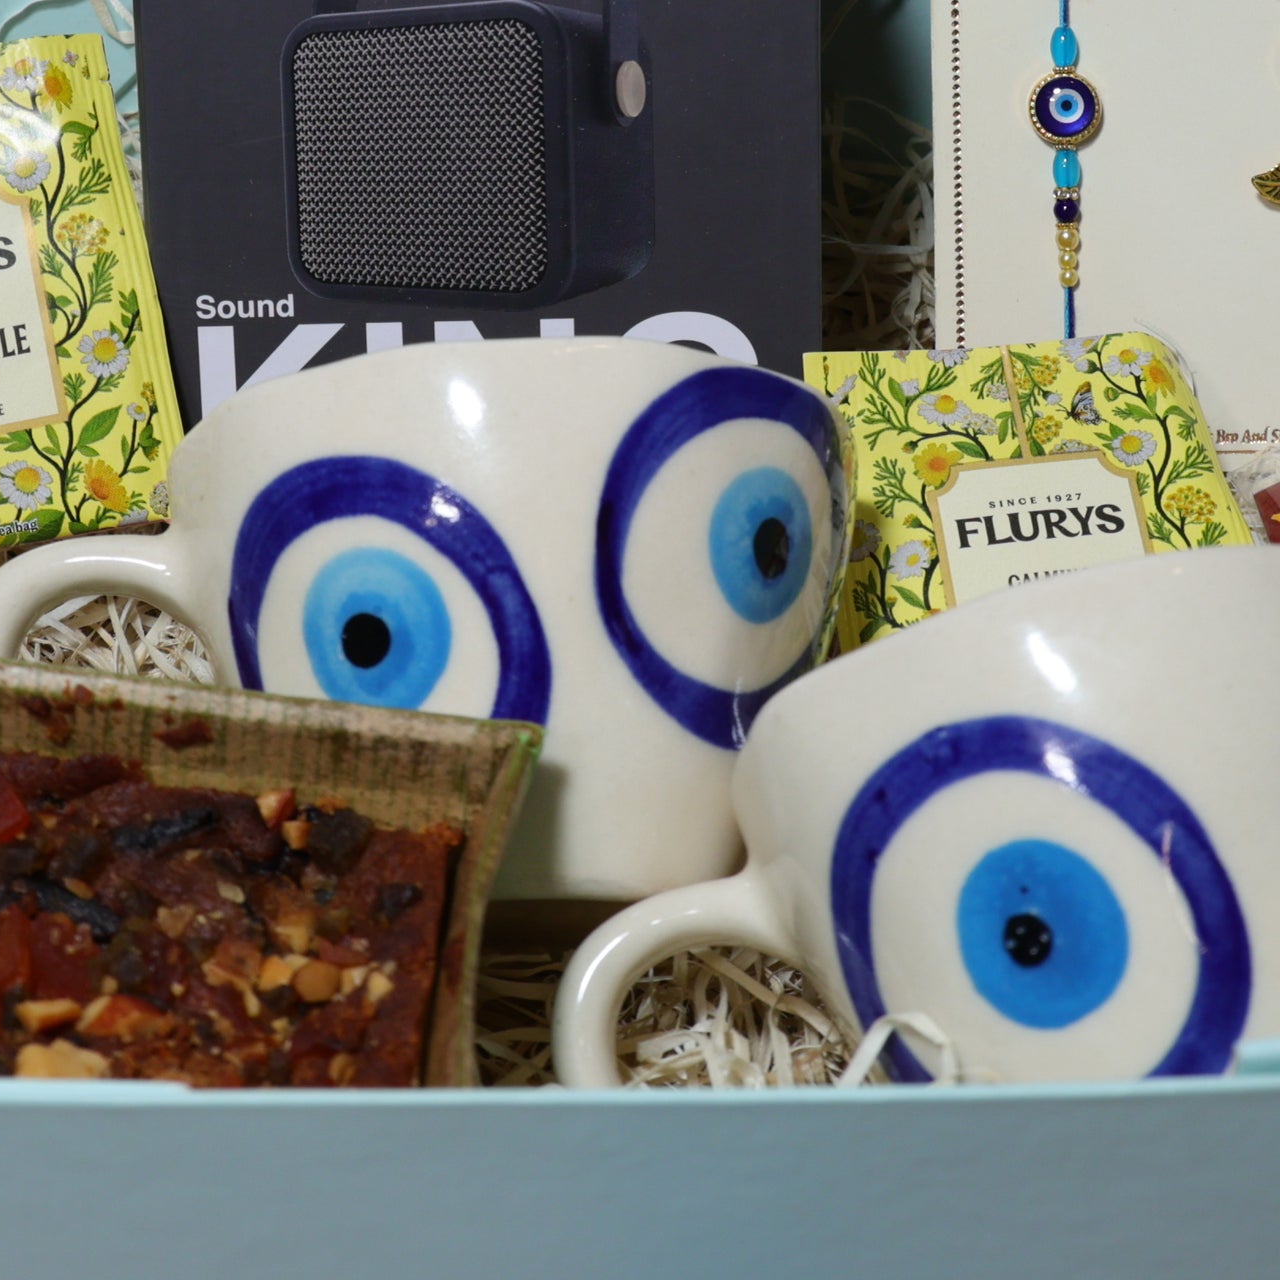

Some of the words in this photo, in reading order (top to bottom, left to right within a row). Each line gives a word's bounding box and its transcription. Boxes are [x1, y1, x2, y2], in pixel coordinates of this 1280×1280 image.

[195, 293, 295, 320] Sound
[1216, 428, 1239, 444] Bro
[1241, 426, 1270, 444] And
[988, 496, 1038, 509] SINCE
[1046, 492, 1082, 503] 1927
[14, 519, 38, 532] bag
[955, 503, 1125, 549] FLURYS
